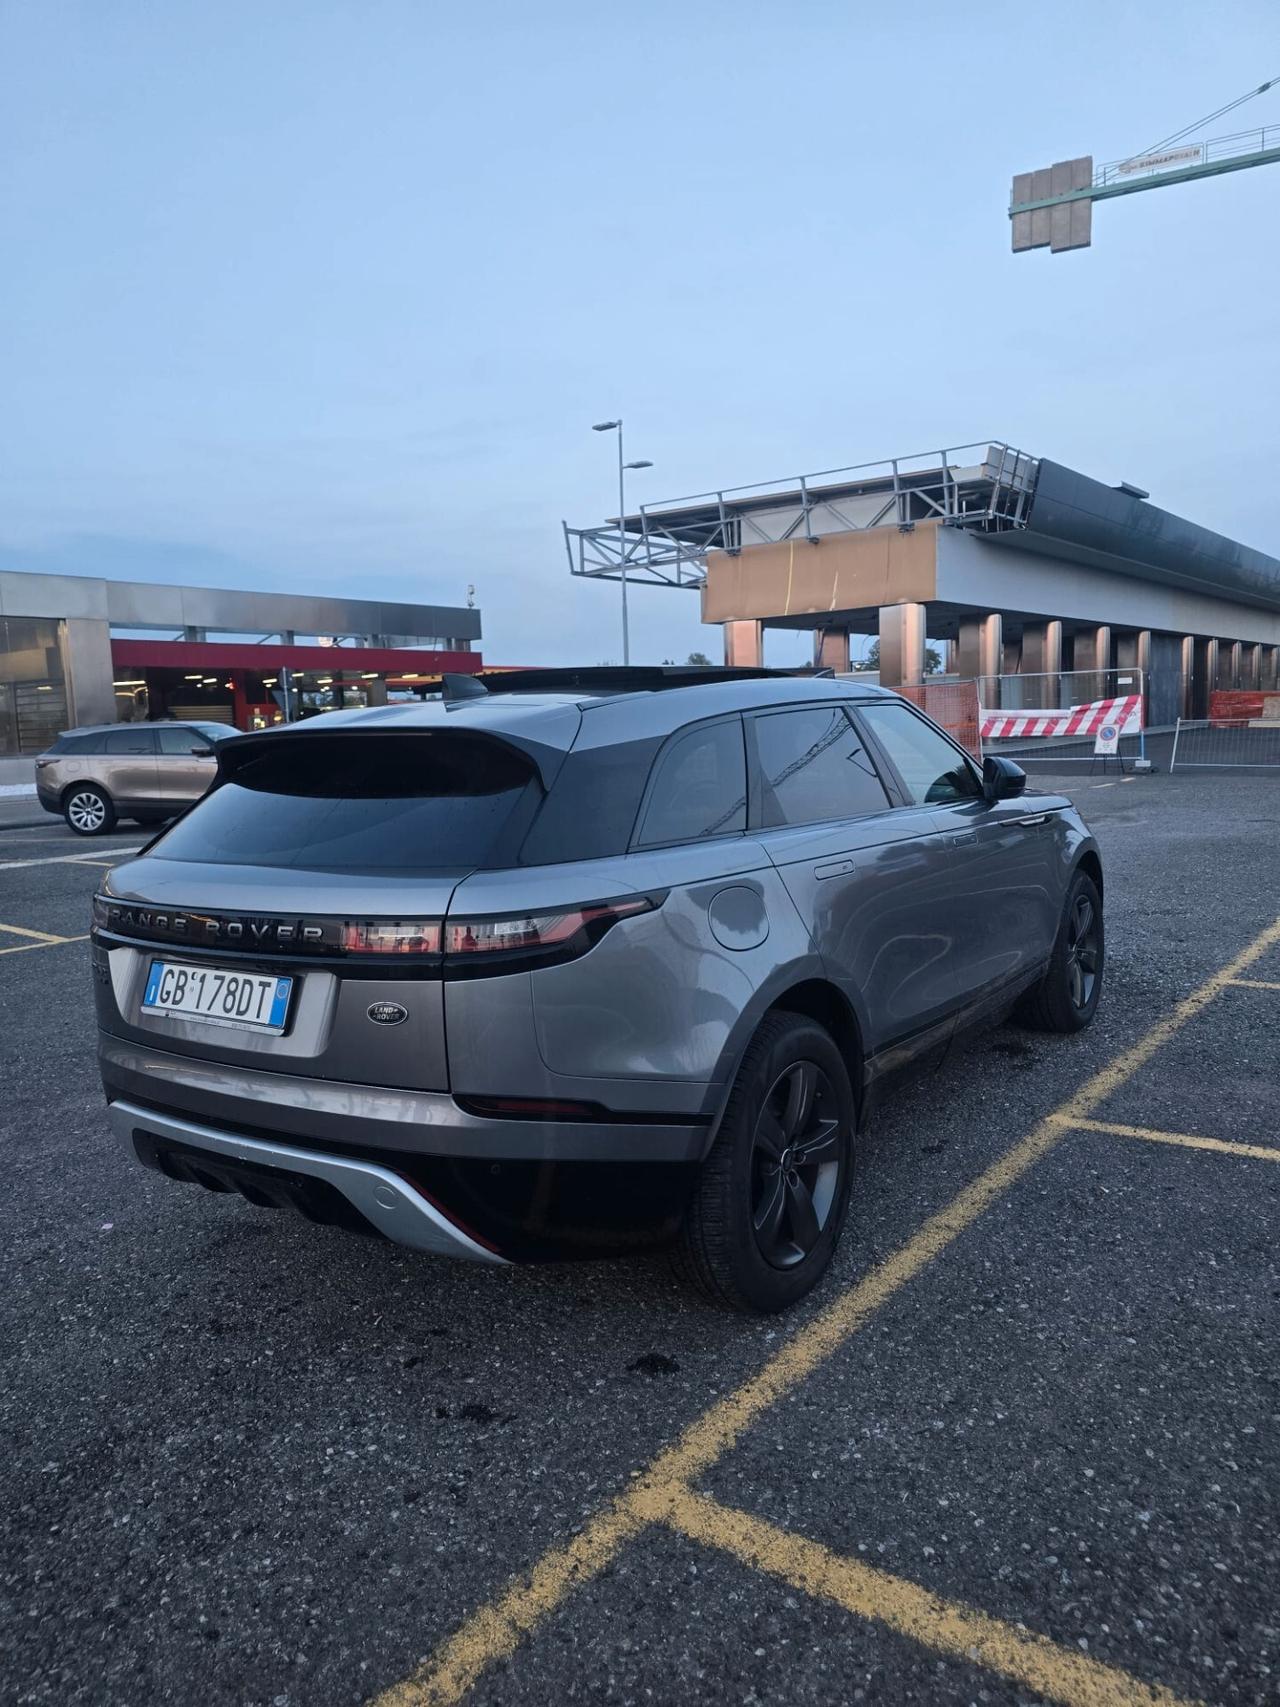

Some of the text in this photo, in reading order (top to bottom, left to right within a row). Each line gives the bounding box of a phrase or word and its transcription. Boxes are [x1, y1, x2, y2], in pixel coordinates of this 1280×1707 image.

[110, 910, 323, 942] RANGE ROVER
[374, 1006, 394, 1014] LAND
